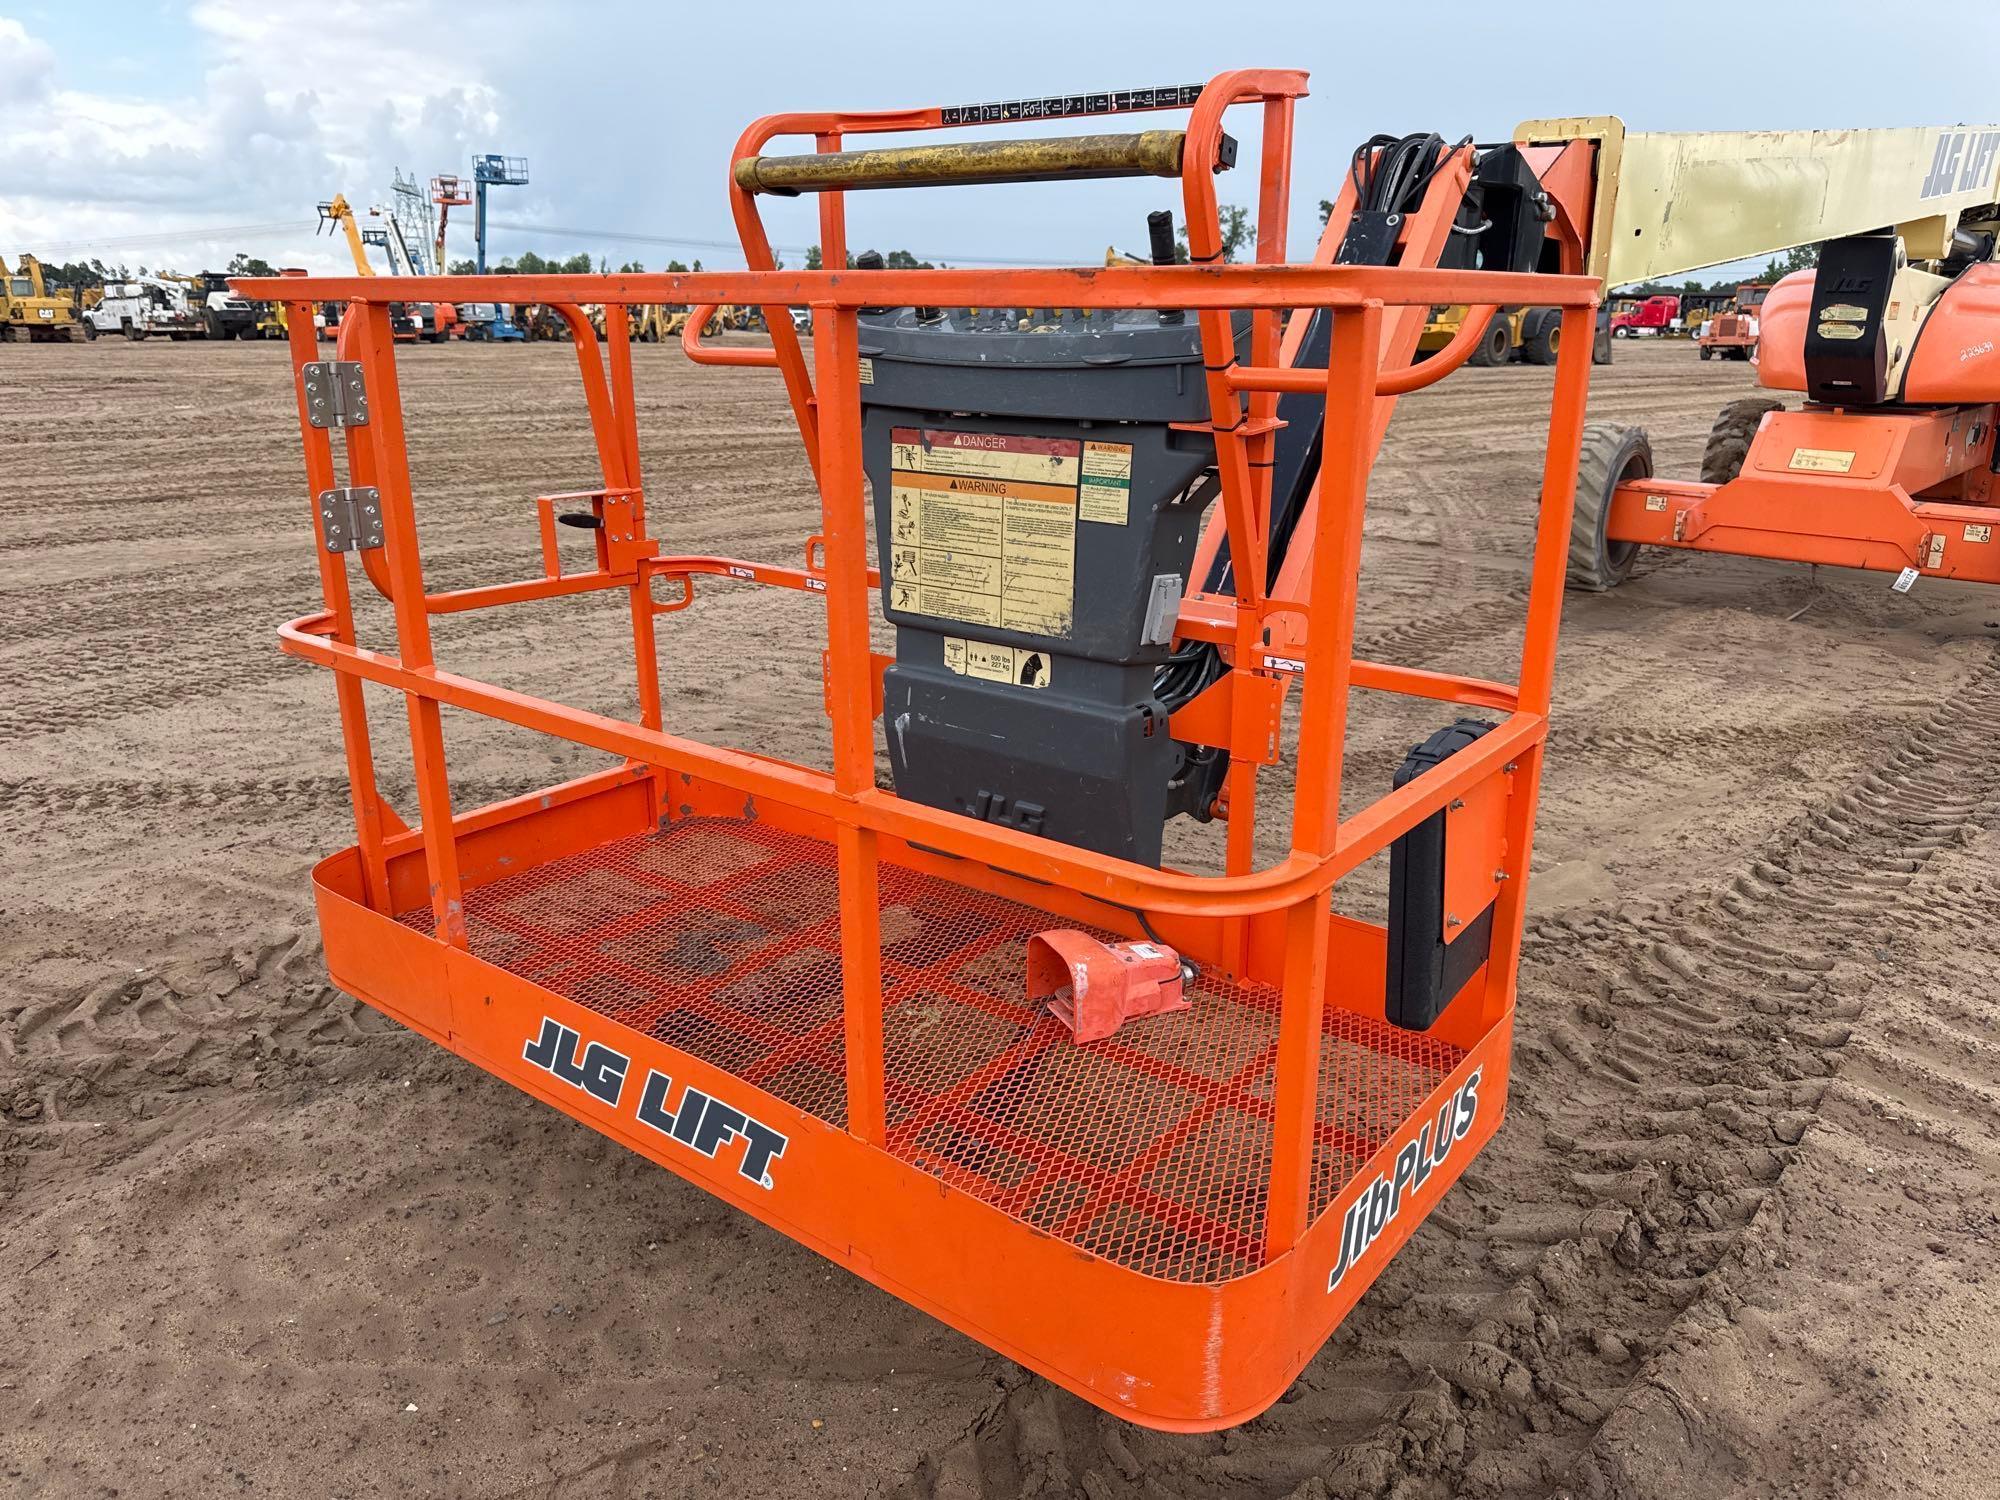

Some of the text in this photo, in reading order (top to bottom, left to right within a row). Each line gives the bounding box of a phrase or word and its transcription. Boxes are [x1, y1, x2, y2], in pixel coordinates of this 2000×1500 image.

[1920, 132, 1966, 200] JLG
[962, 435, 1007, 449] DANGER
[1097, 444, 1126, 453] WARNING
[958, 480, 1007, 495] WARNING
[1088, 477, 1122, 487] IMPORTANT
[991, 661, 1001, 669] 227
[1002, 663, 1010, 671] kg
[1001, 656, 1011, 664] lbs
[522, 1015, 630, 1109] JLG
